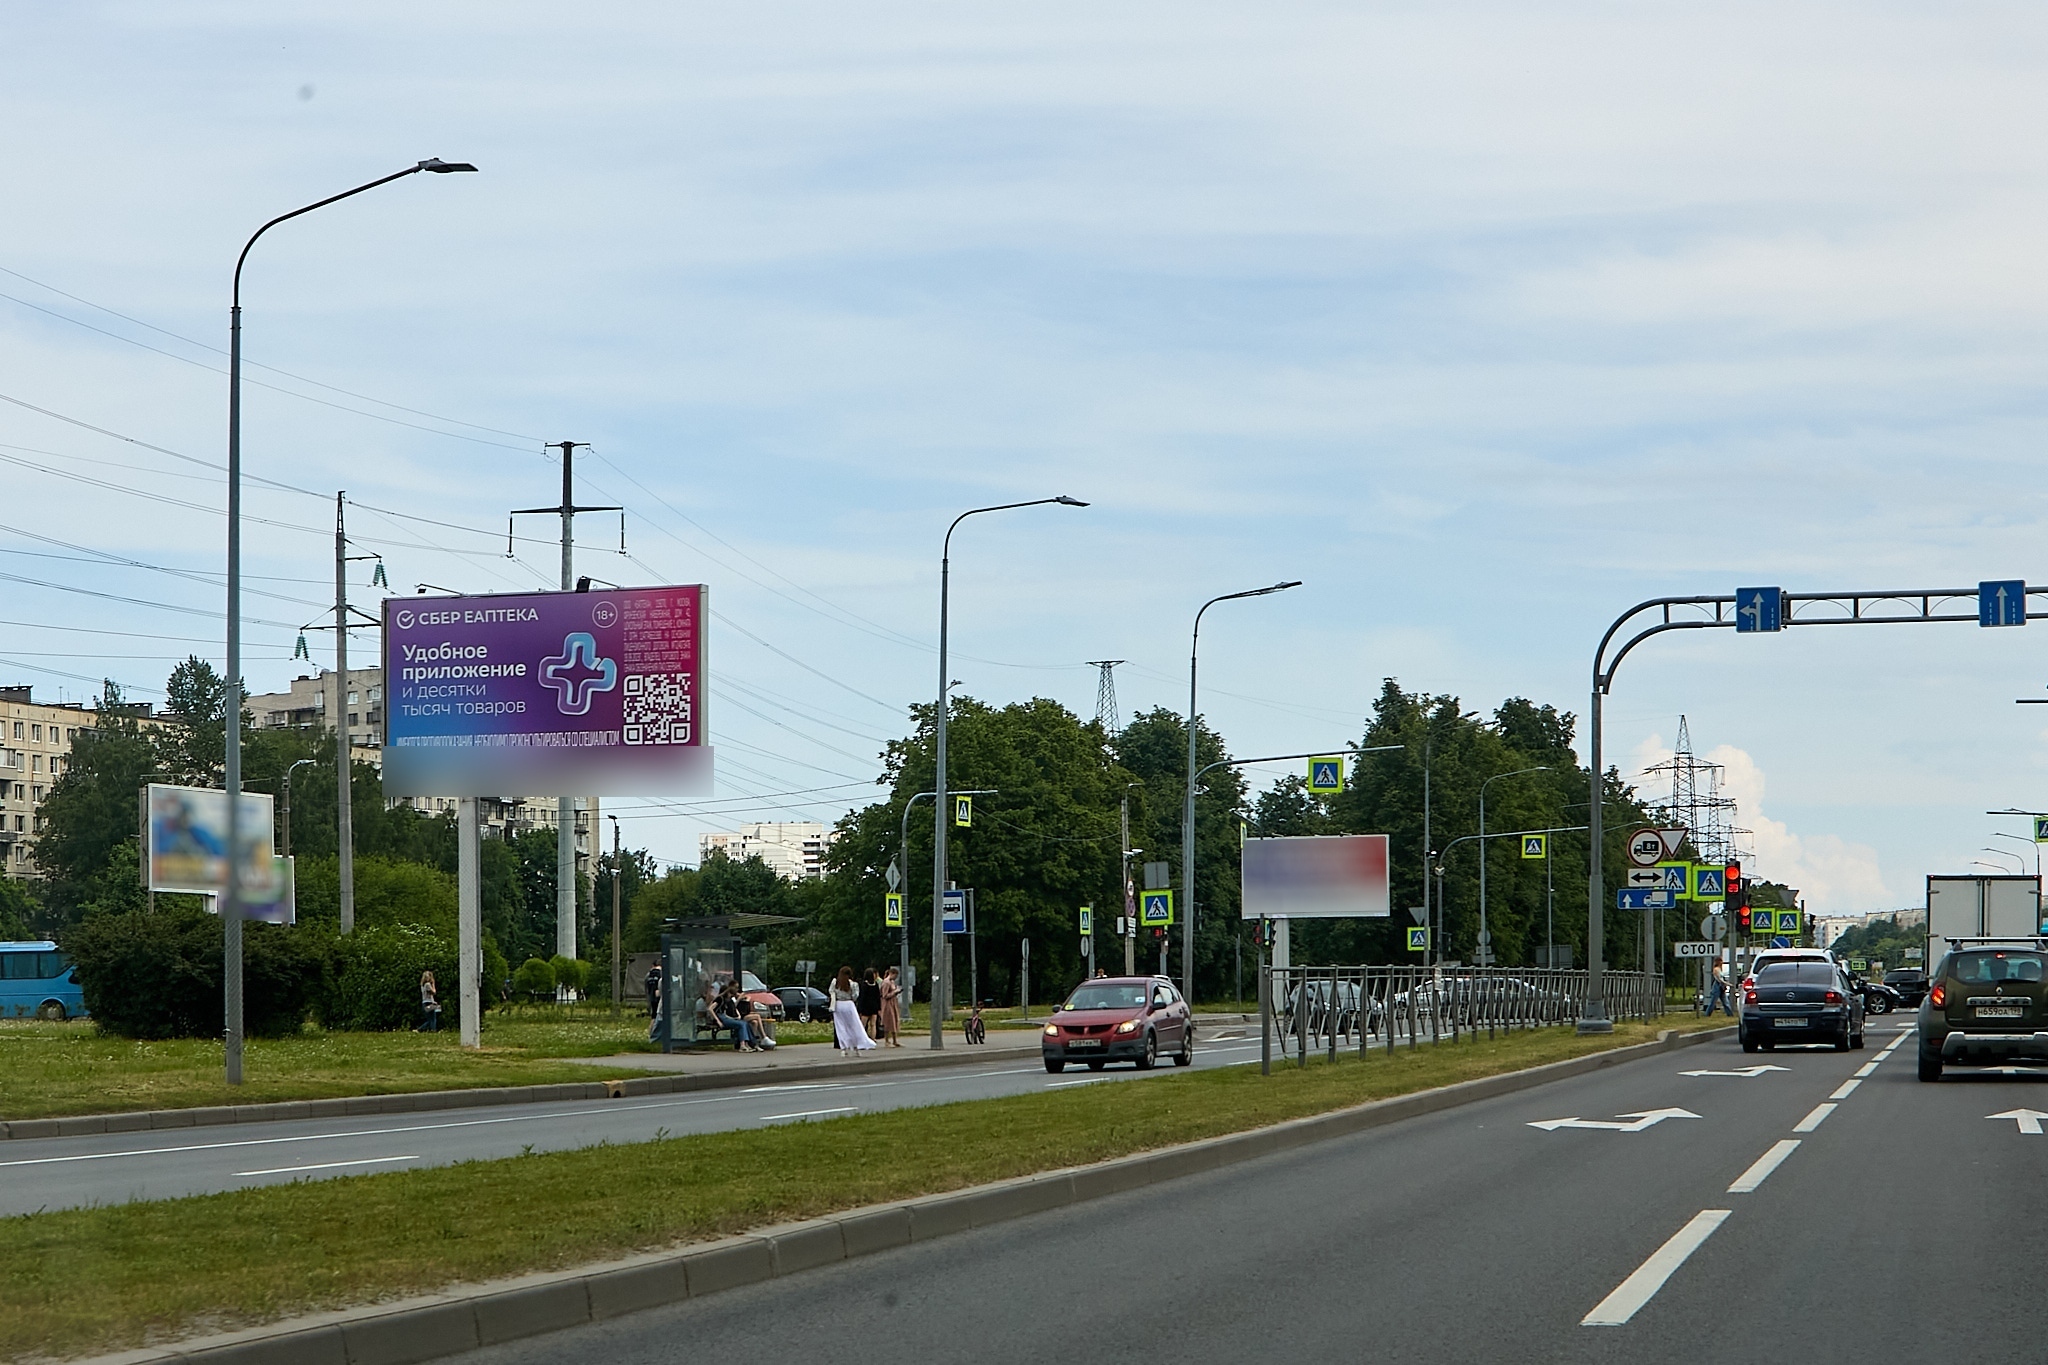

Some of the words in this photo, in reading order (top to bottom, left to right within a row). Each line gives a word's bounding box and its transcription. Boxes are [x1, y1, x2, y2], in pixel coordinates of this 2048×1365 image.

[418, 611, 461, 625] СБЕР
[464, 608, 539, 624] ЕАПТЕКА
[596, 610, 615, 620] 18+
[402, 642, 488, 664] Удобное
[402, 663, 527, 684] приложение
[402, 687, 413, 698] и
[417, 684, 486, 700] десятки
[402, 703, 450, 716] тысяч
[455, 701, 526, 717] товаров
[1681, 944, 1715, 955] СТОП
